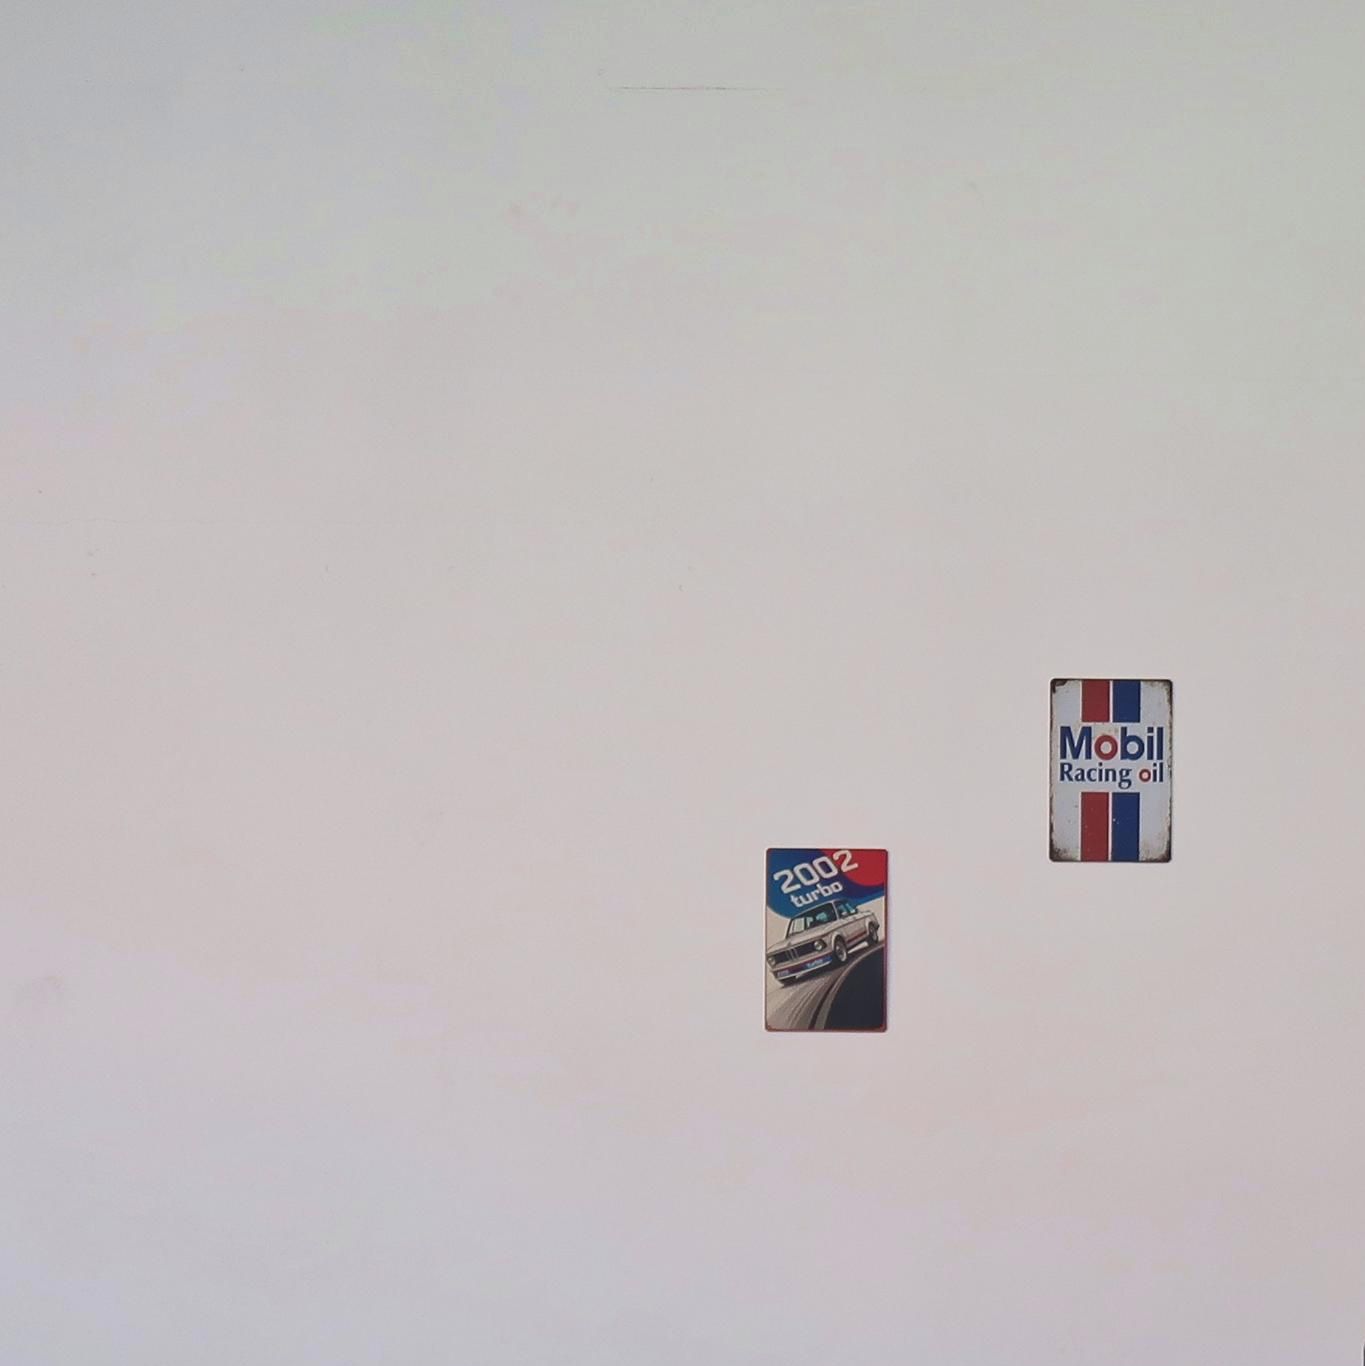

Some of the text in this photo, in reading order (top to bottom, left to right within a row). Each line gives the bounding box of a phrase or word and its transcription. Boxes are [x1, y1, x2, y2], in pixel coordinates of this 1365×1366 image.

[1059, 726, 1164, 761] Mobil
[1059, 762, 1164, 790] Racing oil
[773, 850, 859, 894] 2002
[790, 881, 843, 908] turbo
